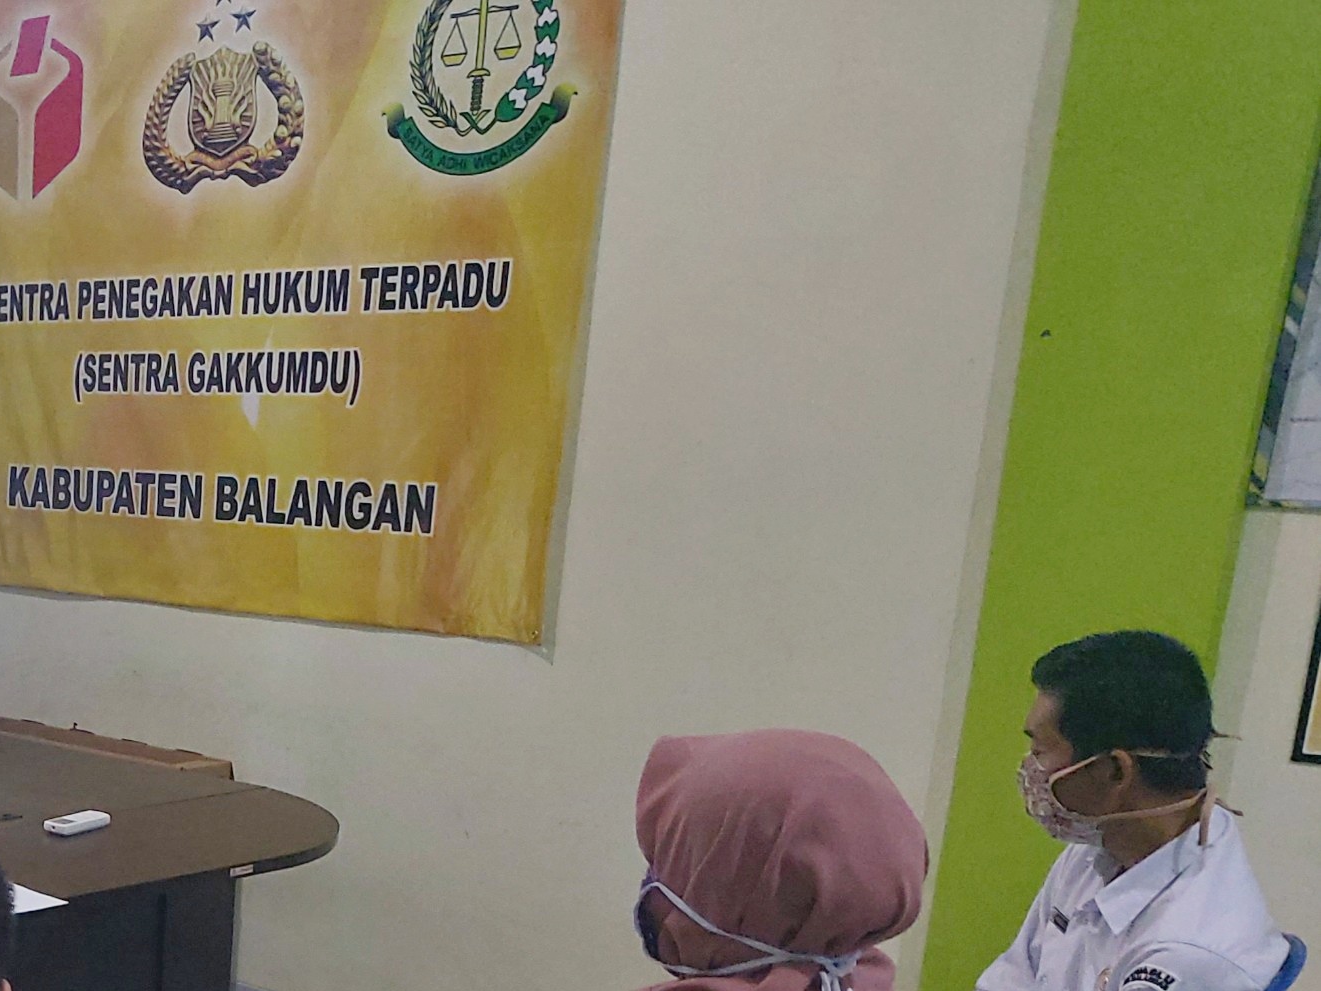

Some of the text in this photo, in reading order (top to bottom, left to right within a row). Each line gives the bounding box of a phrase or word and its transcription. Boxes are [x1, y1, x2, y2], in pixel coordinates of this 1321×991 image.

[403, 126, 435, 163] SATYA
[437, 157, 467, 170] ADHI
[77, 274, 234, 320] PENEGAKAN
[241, 268, 350, 315] HUKUM
[360, 261, 511, 311] TERPADU
[75, 349, 361, 406] (SENTRA GAKKUMDU)
[8, 466, 435, 534] KABUPATEN BALANGAN
